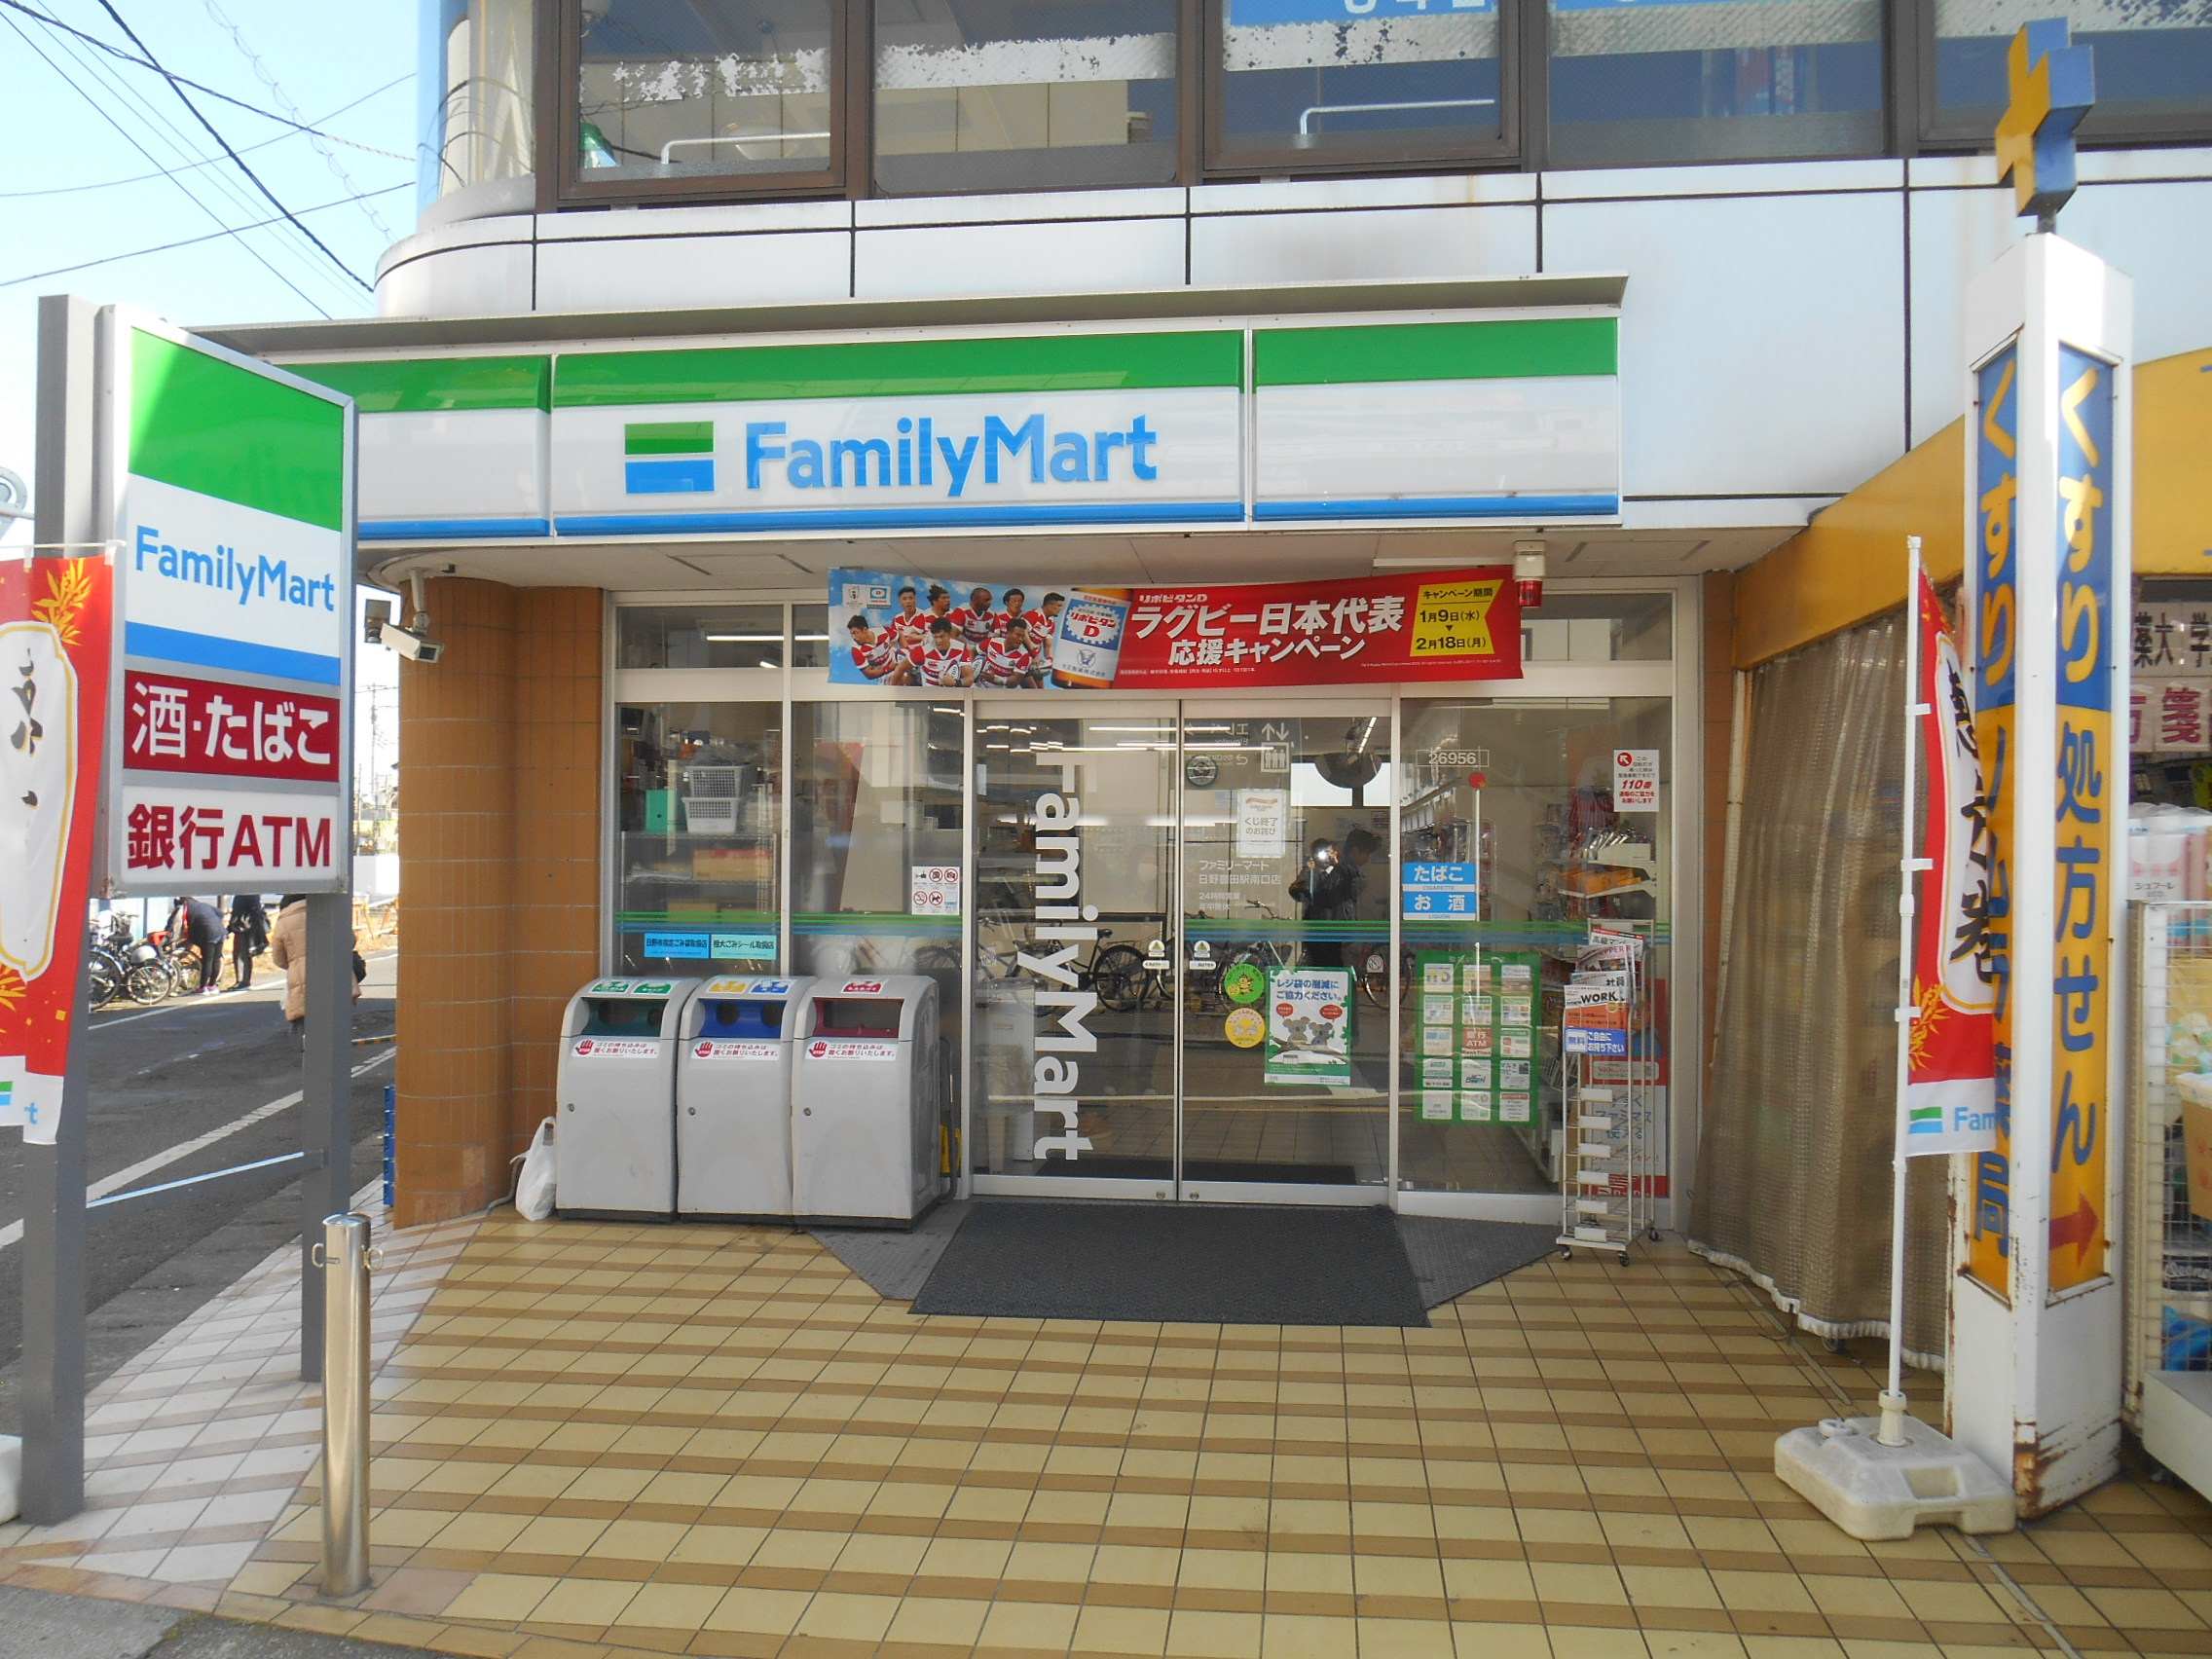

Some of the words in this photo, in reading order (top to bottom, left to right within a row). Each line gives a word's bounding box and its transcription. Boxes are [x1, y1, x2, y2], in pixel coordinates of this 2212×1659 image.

[746, 414, 1157, 497] FamilyMart
[1980, 358, 2017, 686] くすり
[2059, 366, 2104, 682] くすり
[135, 525, 335, 611] FamilyMart
[1139, 594, 1207, 604] リポビタンD
[1423, 587, 1493, 600] キャンペーン期間
[1071, 611, 1116, 628] リポビタン
[1131, 595, 1405, 639] ラグビー日本代表
[1083, 625, 1100, 638] D
[1168, 636, 1365, 666] 応援キャンペーン
[1428, 752, 1477, 764] 26956
[1622, 780, 1652, 789] 110番
[1245, 817, 1277, 826] くじ終了
[127, 803, 331, 869] 銀行ATM
[1198, 860, 1270, 870] ファミリーマート
[1414, 866, 1463, 882] たばこ
[1017, 753, 1099, 1161] FamilyMart
[1276, 978, 1339, 989] レジ袋の削減に
[1588, 1032, 1612, 1042] ご自由に
[1588, 1043, 1625, 1052] お持ち下さい
